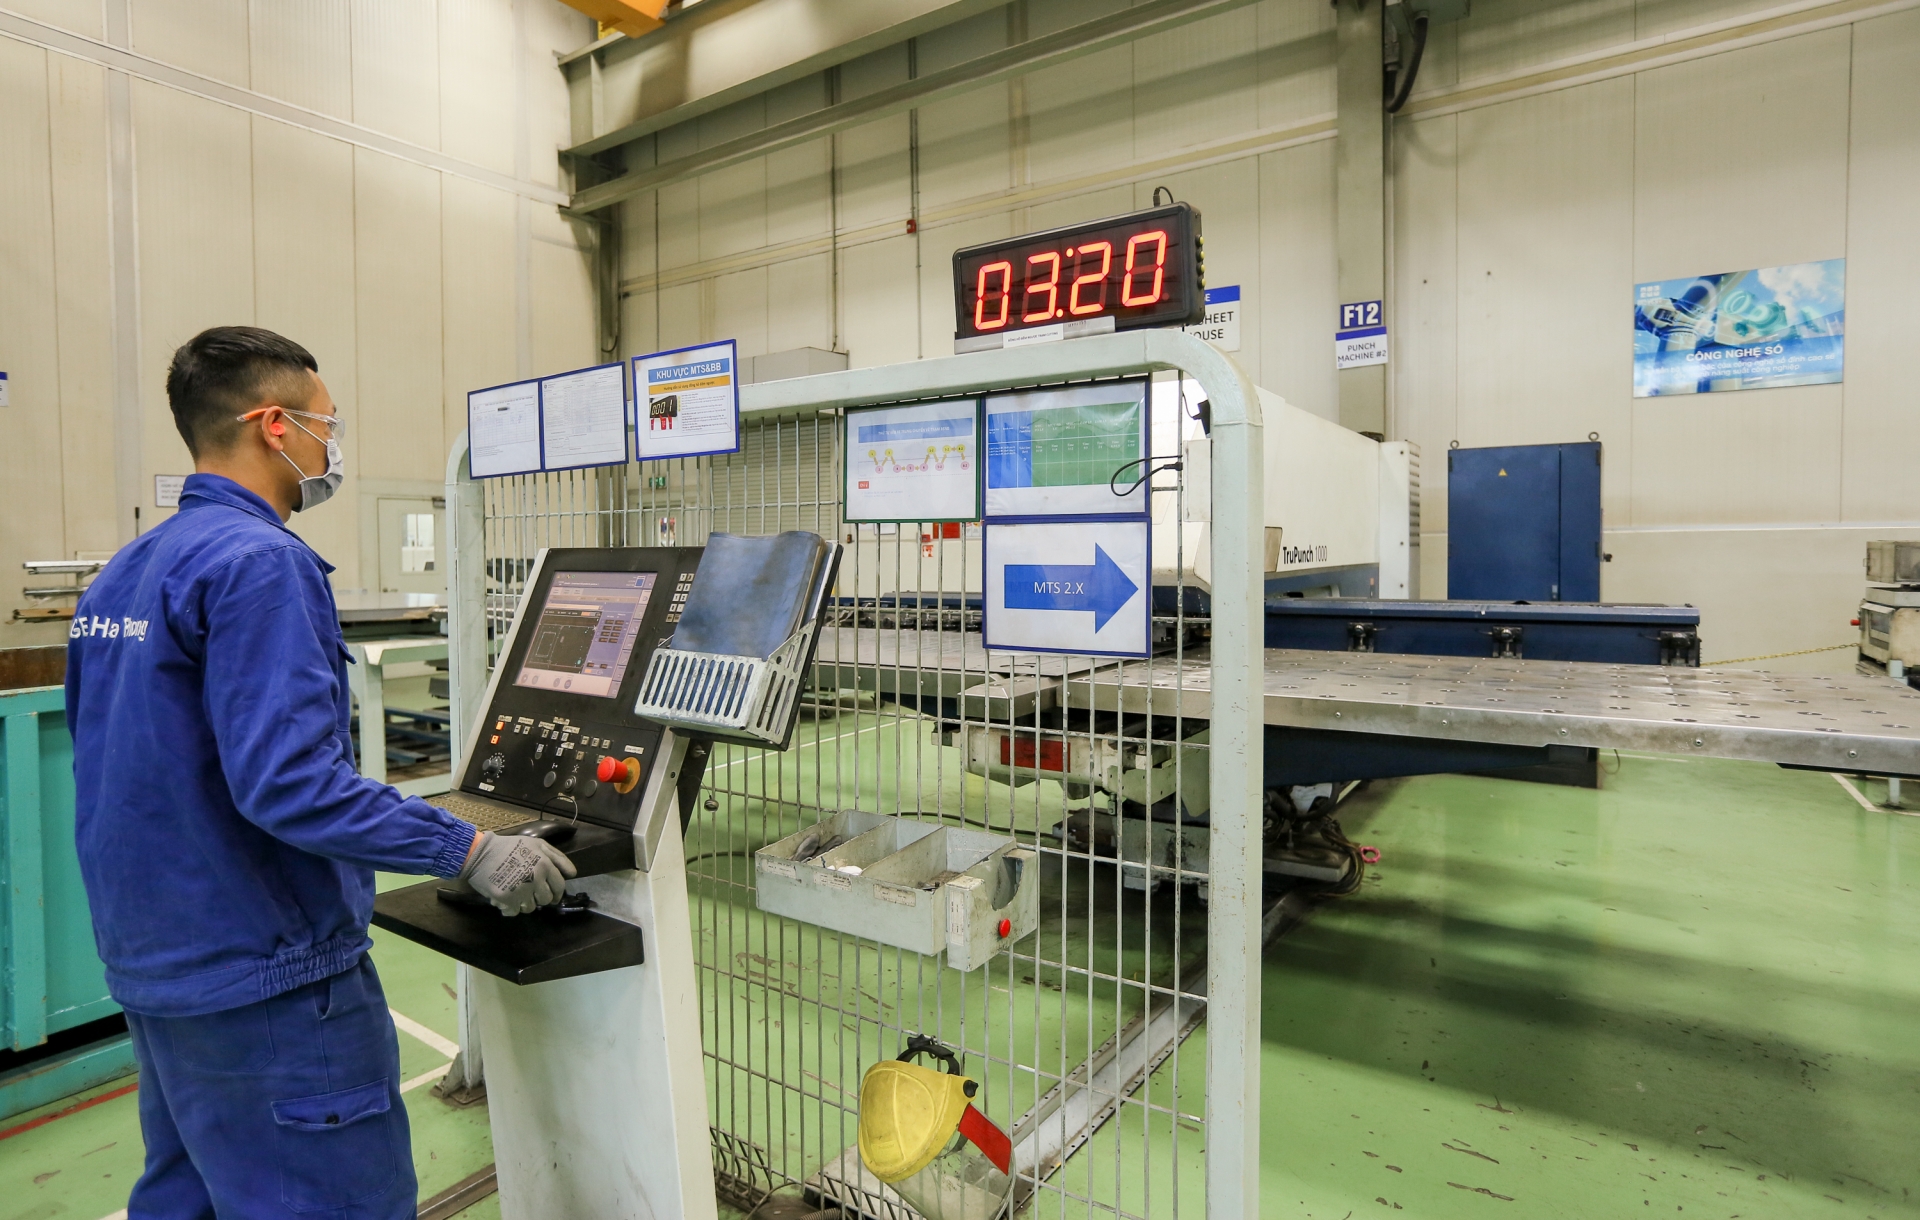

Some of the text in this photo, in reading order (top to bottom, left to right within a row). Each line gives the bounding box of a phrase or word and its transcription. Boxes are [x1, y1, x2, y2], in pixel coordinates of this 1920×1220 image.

[1201, 310, 1234, 325] HEET
[1344, 303, 1379, 327] F12
[1190, 329, 1224, 340] OUSE
[1347, 342, 1376, 352] PUNCH
[1686, 350, 1722, 361] CÔNG
[1725, 346, 1761, 358] NGHỆ
[1337, 351, 1374, 362] MACHINE
[657, 362, 721, 379] KHU VỰC MTS&BB
[1283, 544, 1328, 565] TruPunch 1000
[1034, 581, 1084, 595] MTS 2.X
